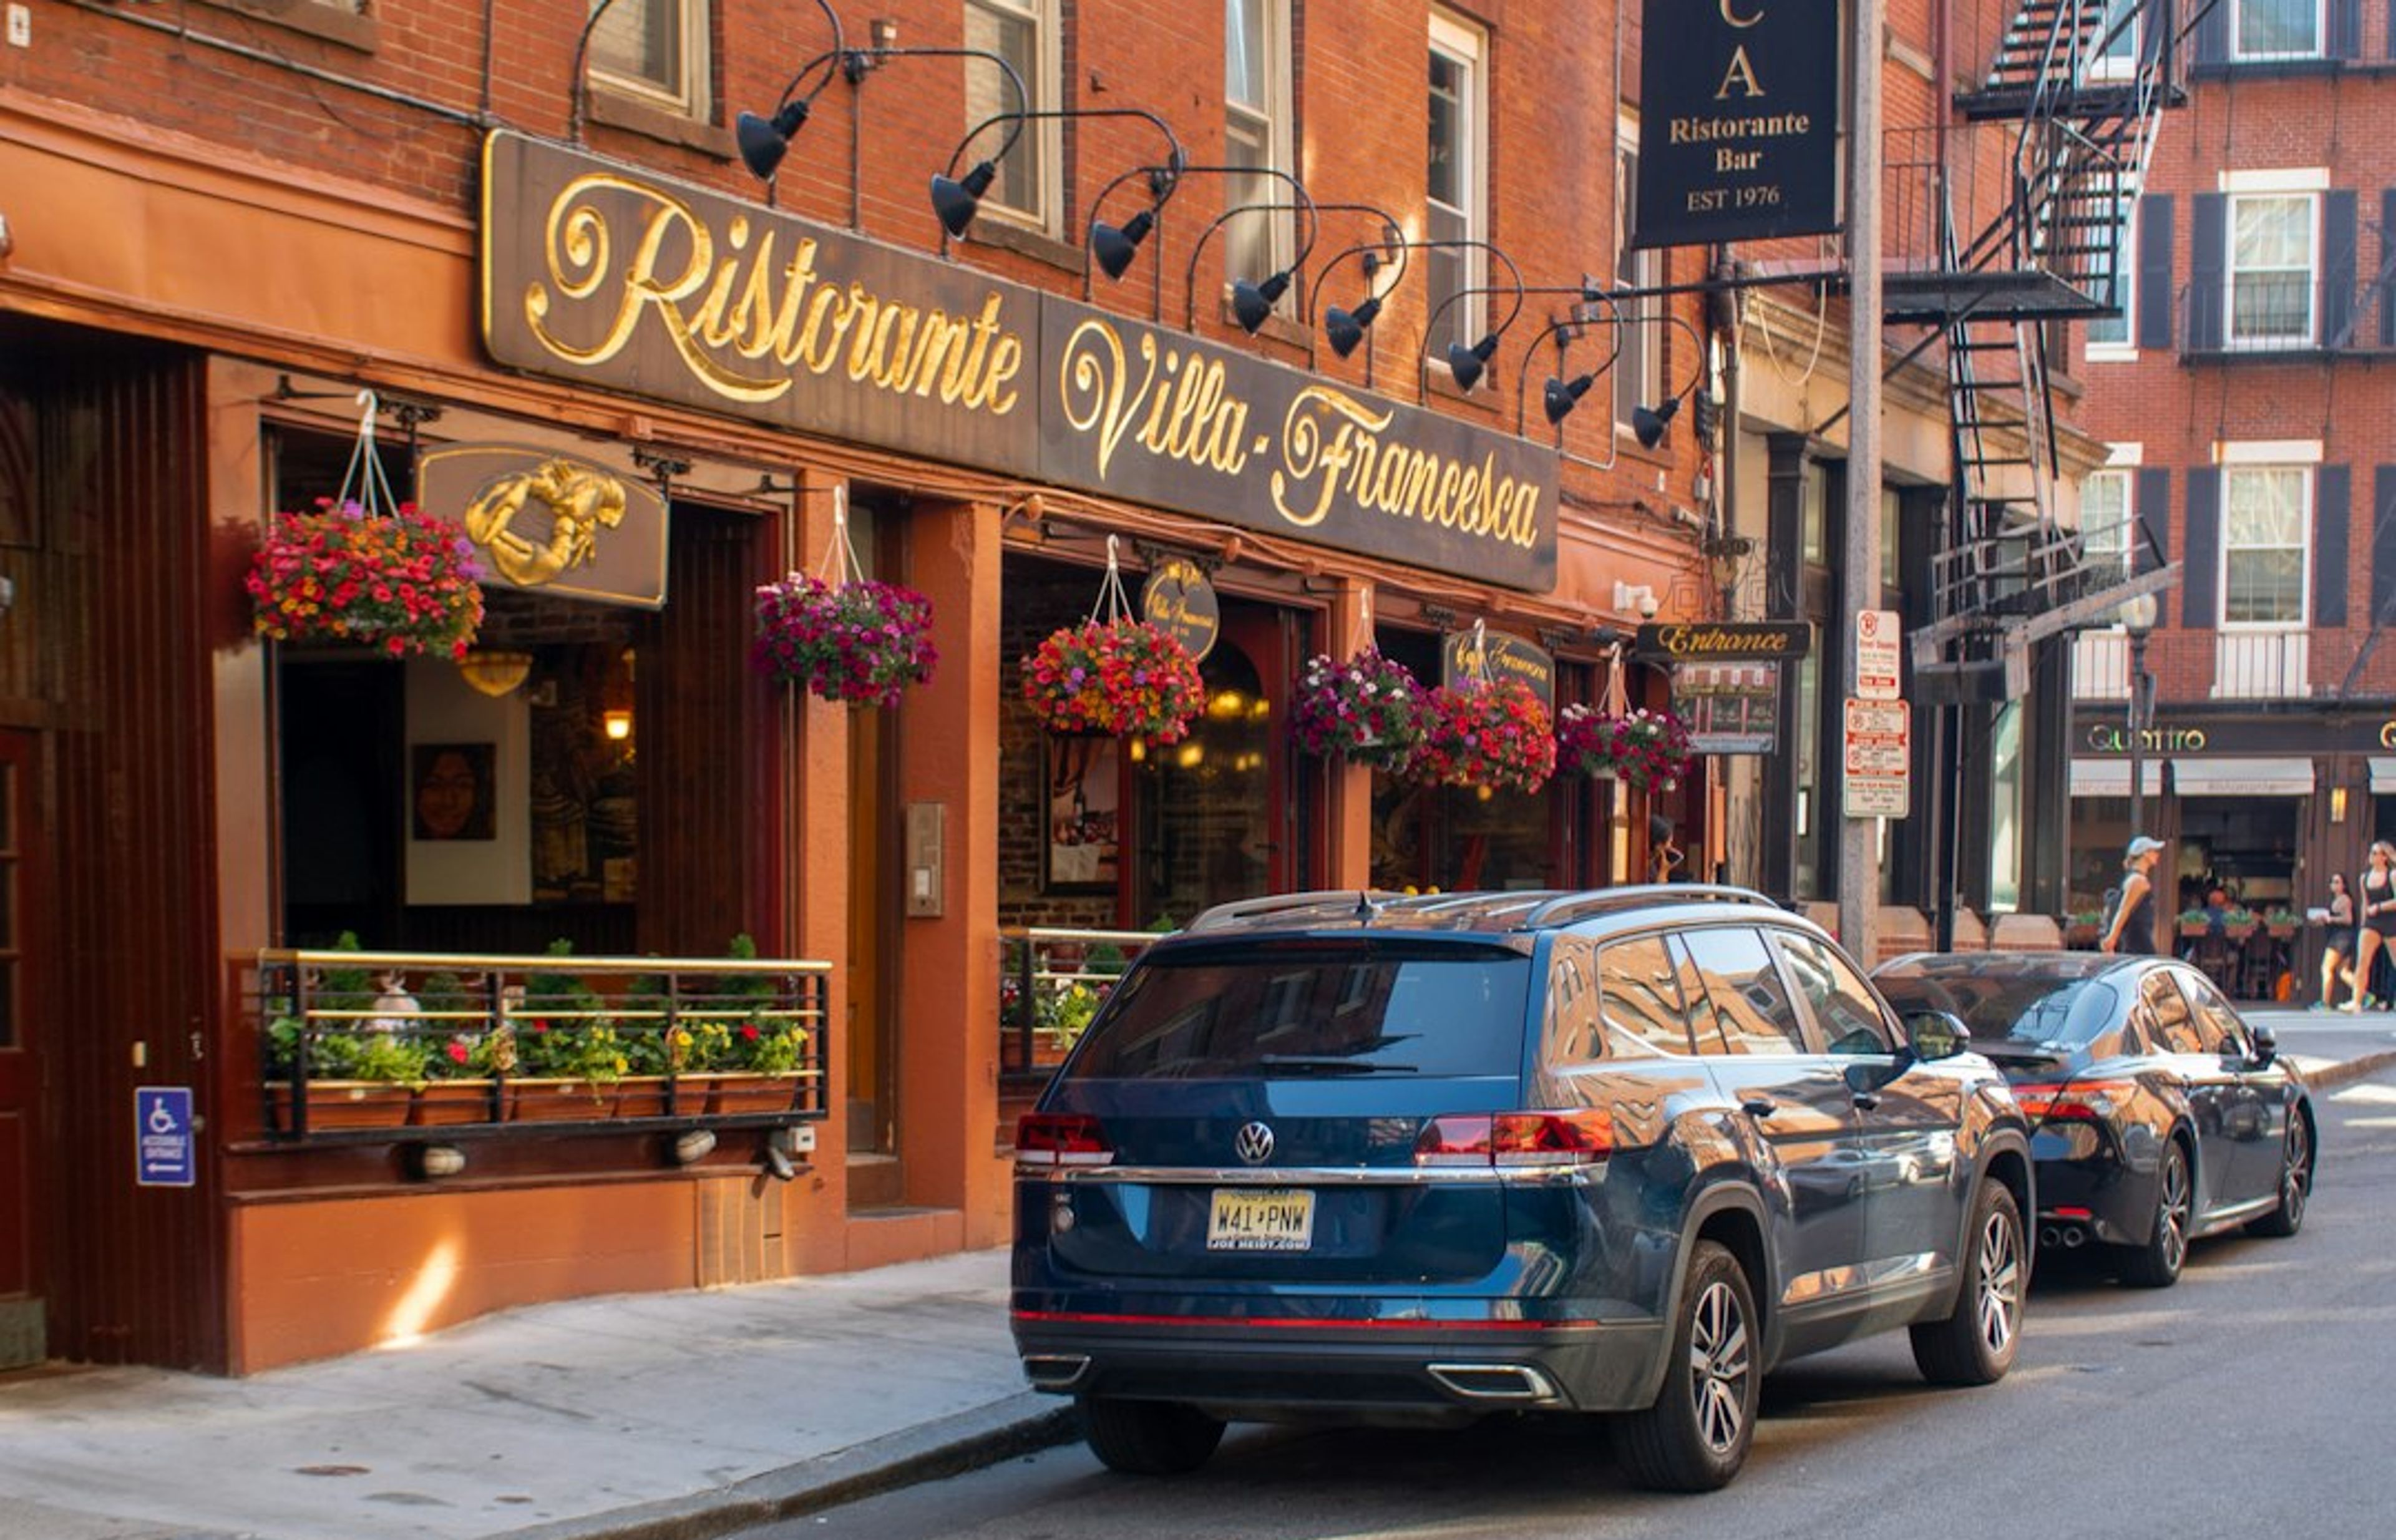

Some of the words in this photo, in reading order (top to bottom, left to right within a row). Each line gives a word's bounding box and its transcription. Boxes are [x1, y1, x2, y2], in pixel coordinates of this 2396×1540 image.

[1670, 111, 1810, 145] Ristorante
[1717, 148, 1762, 172] Bar
[1687, 188, 1729, 213] EST
[1735, 185, 1780, 208] 1976
[525, 171, 1022, 416] Ristorante
[1061, 319, 1249, 483] Villa
[1270, 384, 1540, 550] Francesca
[1658, 623, 1789, 653] Entrance
